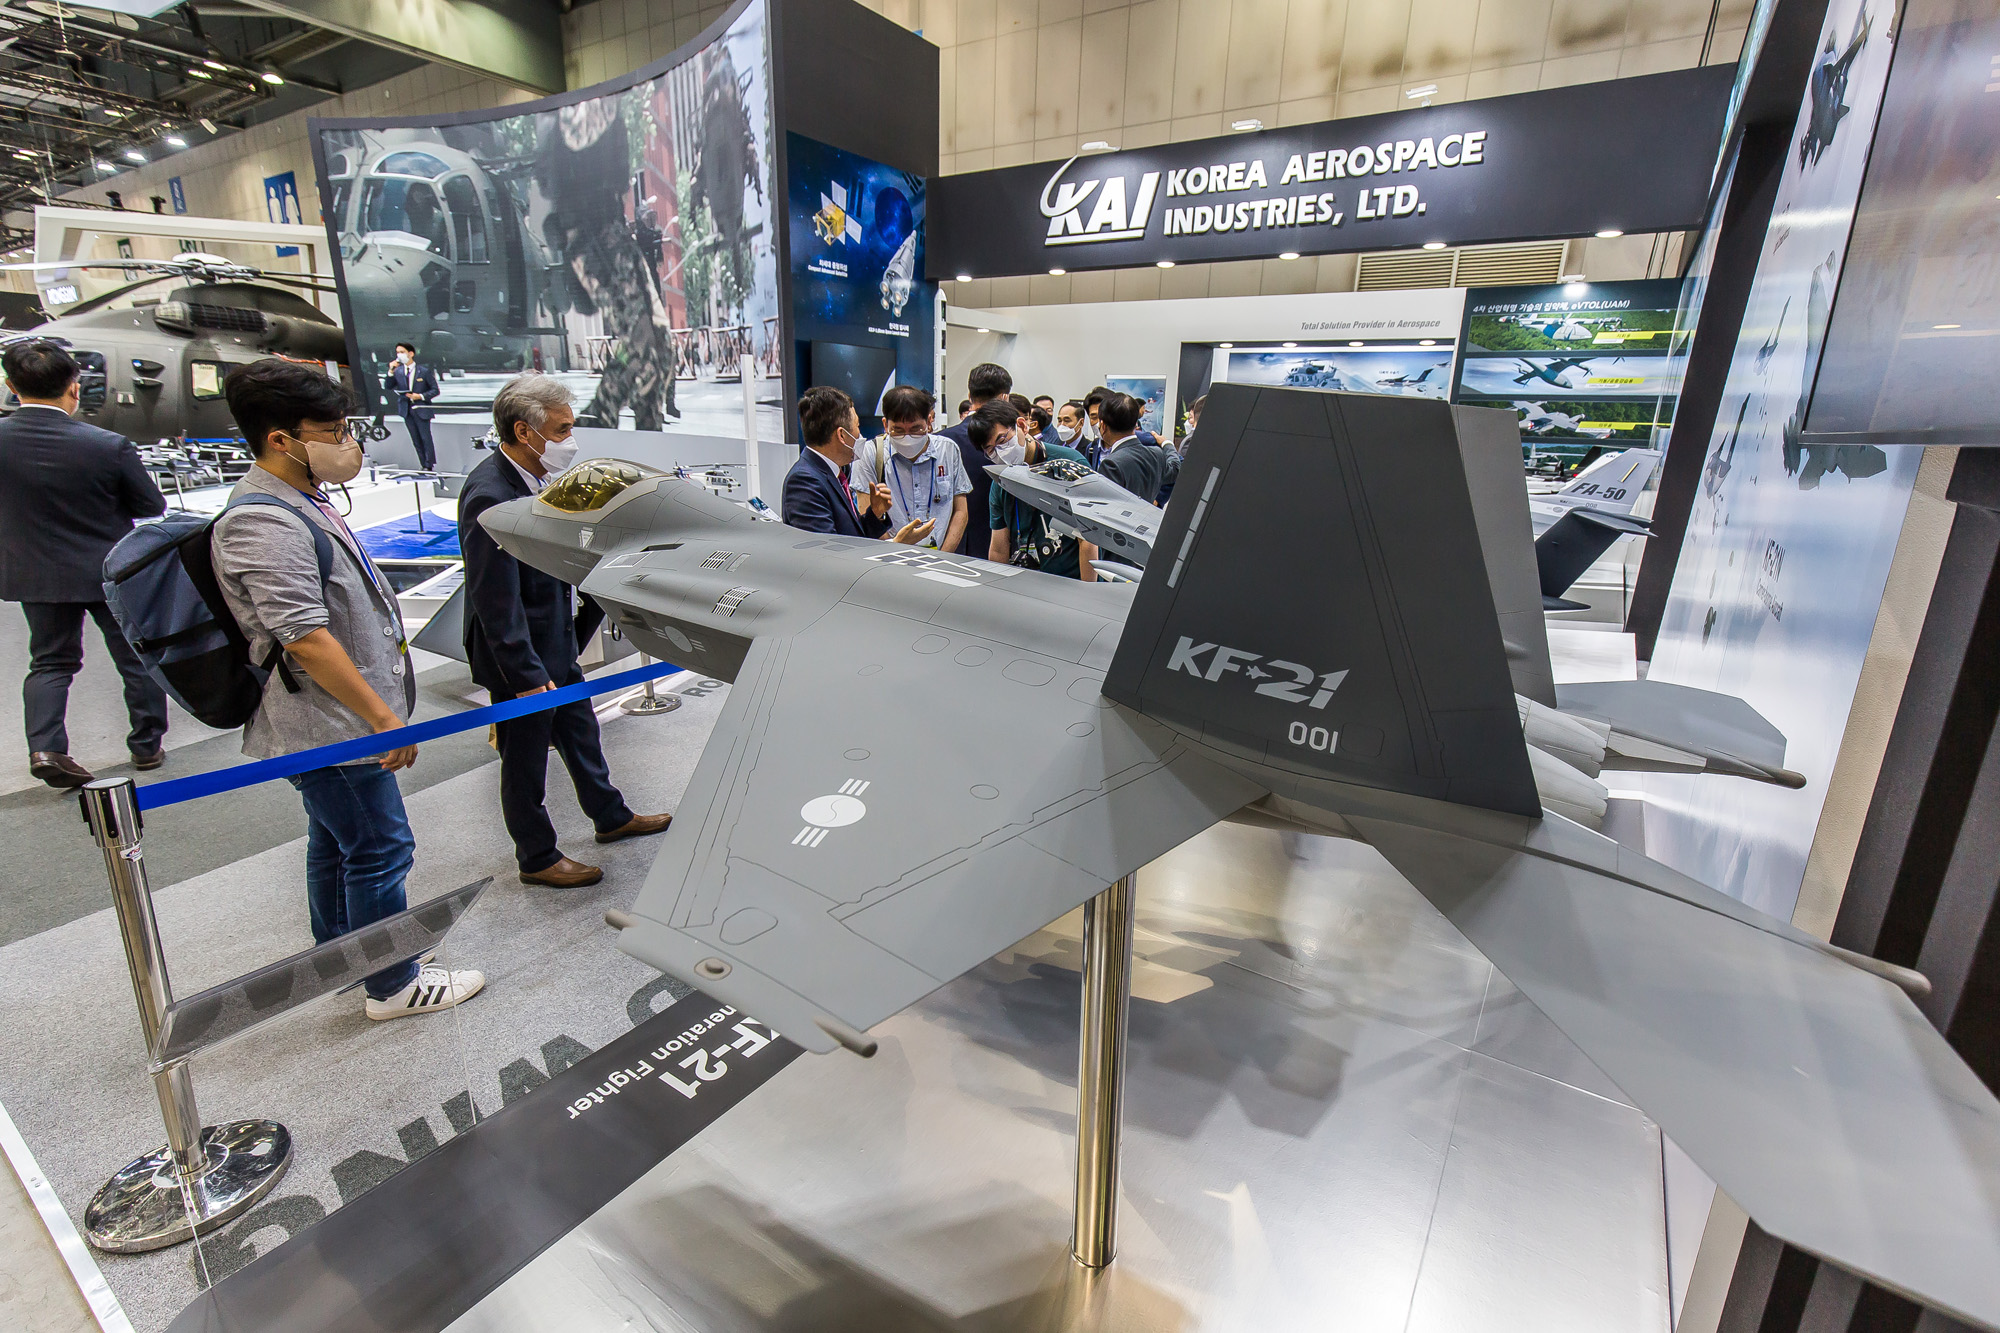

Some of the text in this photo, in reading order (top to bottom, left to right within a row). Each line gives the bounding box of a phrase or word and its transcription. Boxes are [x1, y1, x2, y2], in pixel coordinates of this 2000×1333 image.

[1166, 131, 1488, 197] KOREA AEROSPACE
[1041, 158, 1161, 243] KAI
[1163, 184, 1427, 236] INDUSTRIES, LTD.
[1301, 320, 1441, 330] Total Solution Provider in Aerospace
[1473, 305, 1486, 313] 4차
[1519, 303, 1543, 312] 기술의
[1571, 299, 1631, 310] eVTOL(UAM)
[1570, 482, 1627, 501] FA-50
[1288, 721, 1339, 754] 001
[566, 1004, 738, 1120] neration Fighter
